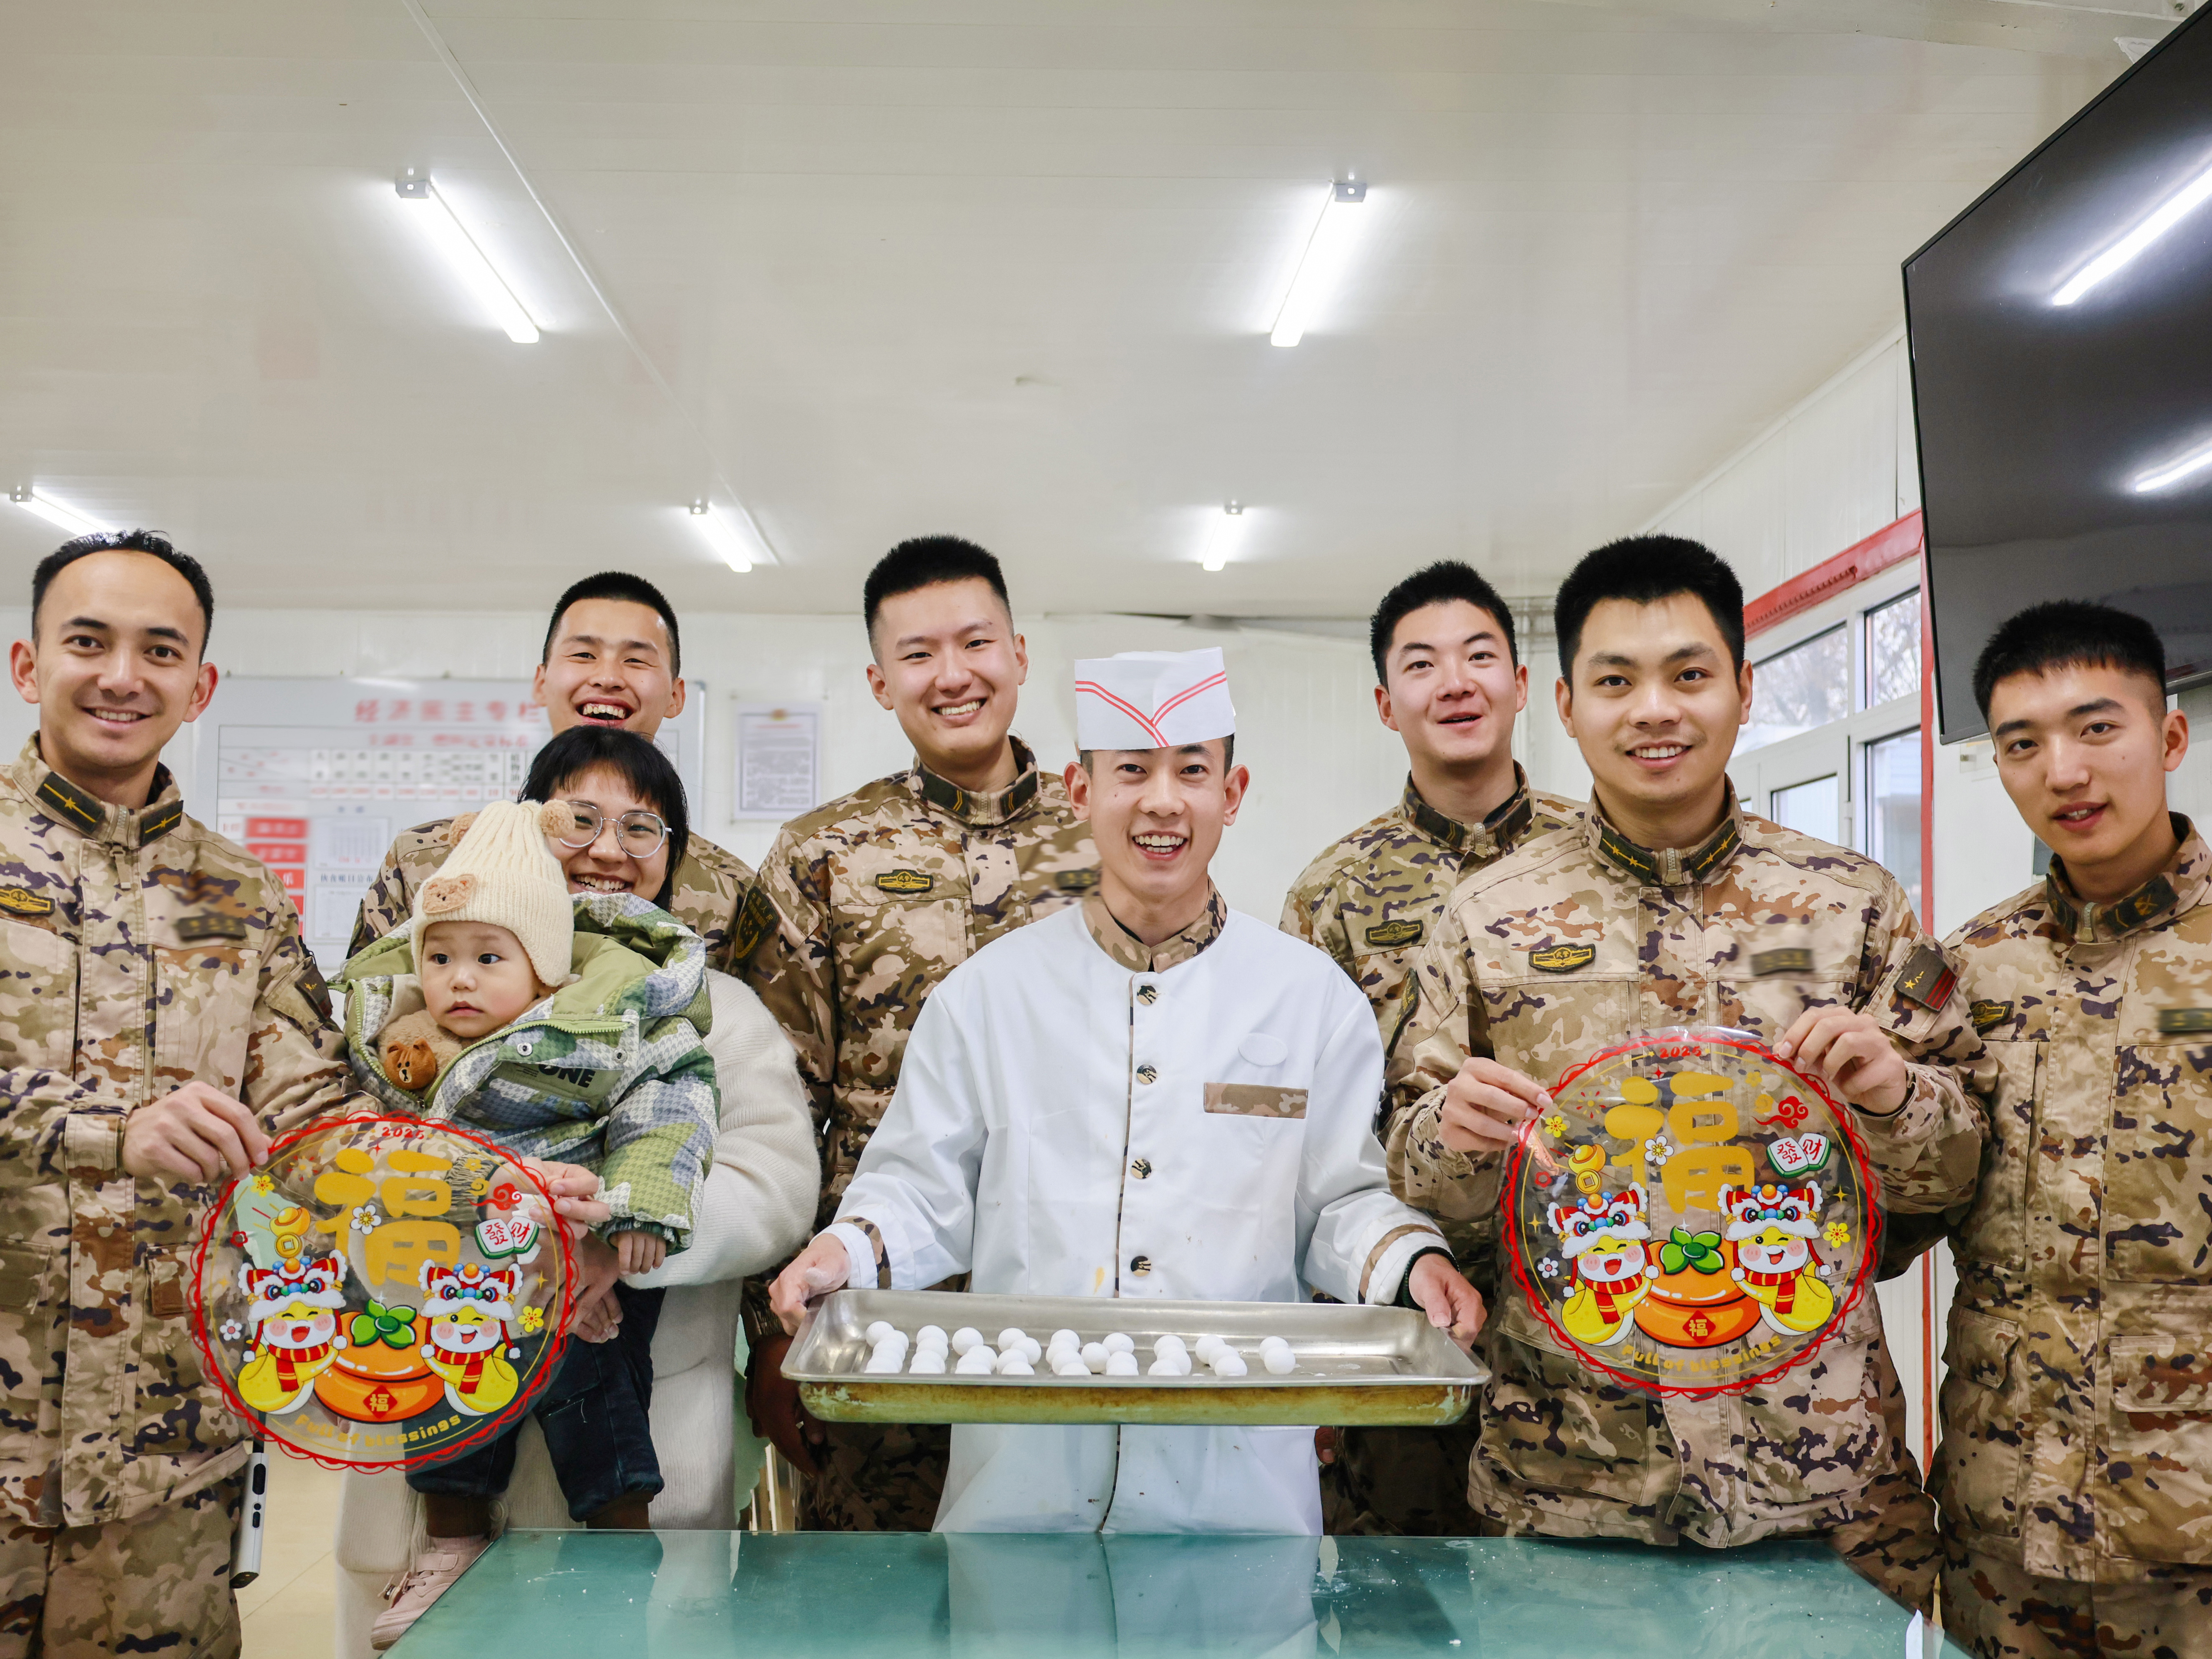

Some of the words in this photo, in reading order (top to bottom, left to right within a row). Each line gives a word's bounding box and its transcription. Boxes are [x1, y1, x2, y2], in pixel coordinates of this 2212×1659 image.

[1660, 1046, 1701, 1058] 2025
[382, 1127, 425, 1139] 2025
[1604, 1071, 1755, 1214] 福
[314, 1148, 460, 1286] 福
[1689, 1319, 1708, 1337] 福
[1622, 1344, 1658, 1366] Full
[1663, 1359, 1685, 1372] of
[1689, 1335, 1782, 1372] blessings
[369, 1394, 389, 1411] 福
[294, 1414, 334, 1438] Full
[337, 1432, 360, 1445] of
[365, 1414, 461, 1447] blessings
